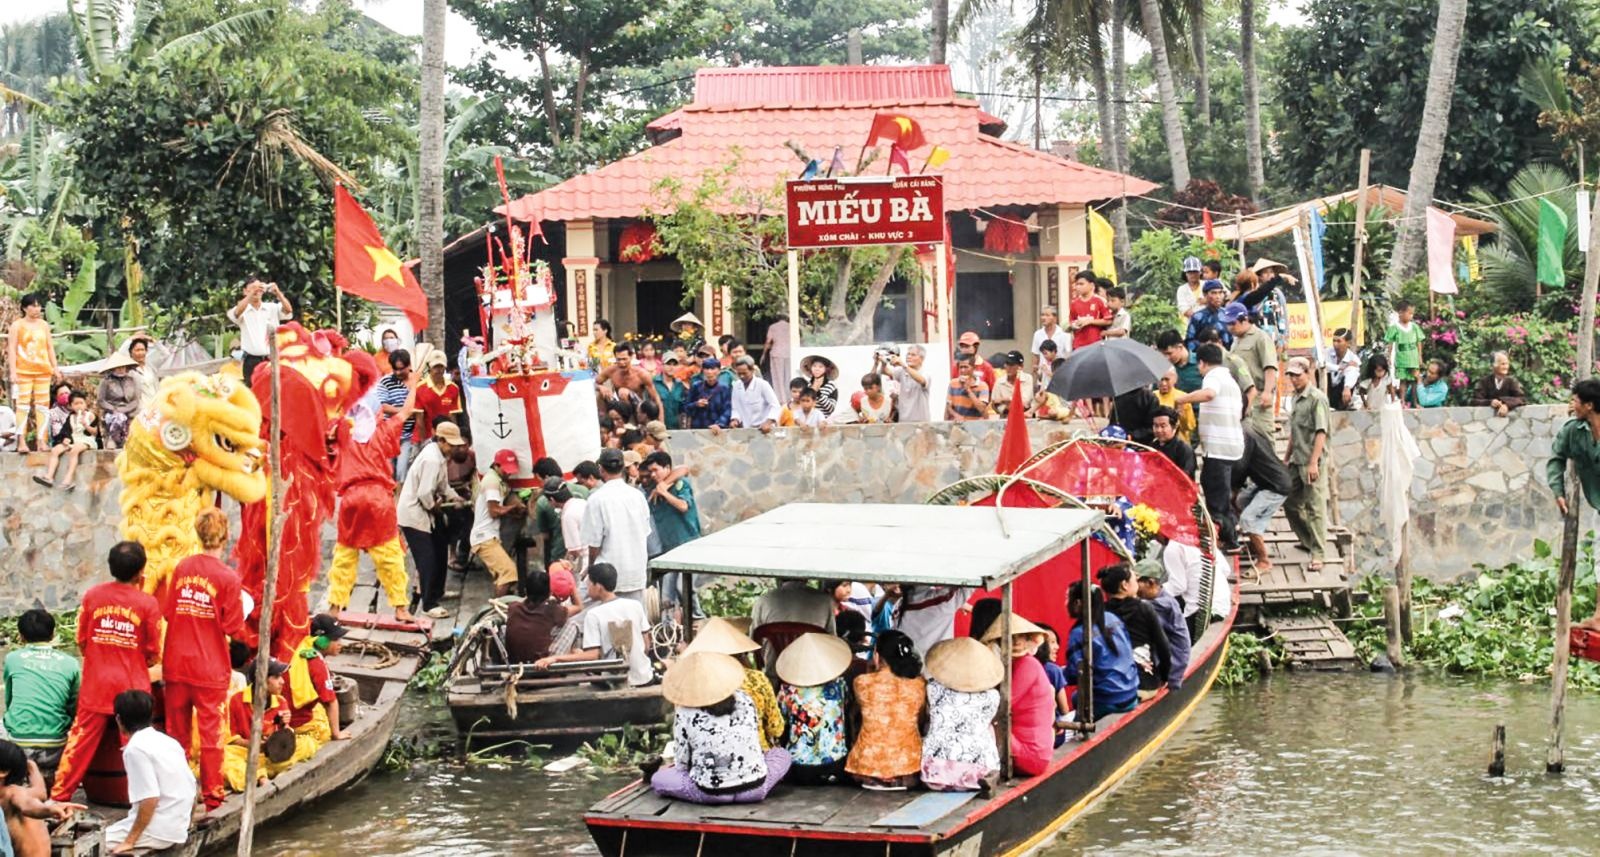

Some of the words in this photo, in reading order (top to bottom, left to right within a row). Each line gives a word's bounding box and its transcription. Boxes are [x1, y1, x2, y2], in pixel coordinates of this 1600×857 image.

[797, 190, 883, 226] MIẾU
[889, 190, 934, 222] BÀ
[818, 233, 838, 242] XÓM
[838, 231, 859, 241] CHÀI
[868, 232, 886, 240] KHU
[887, 231, 904, 241] VỰC
